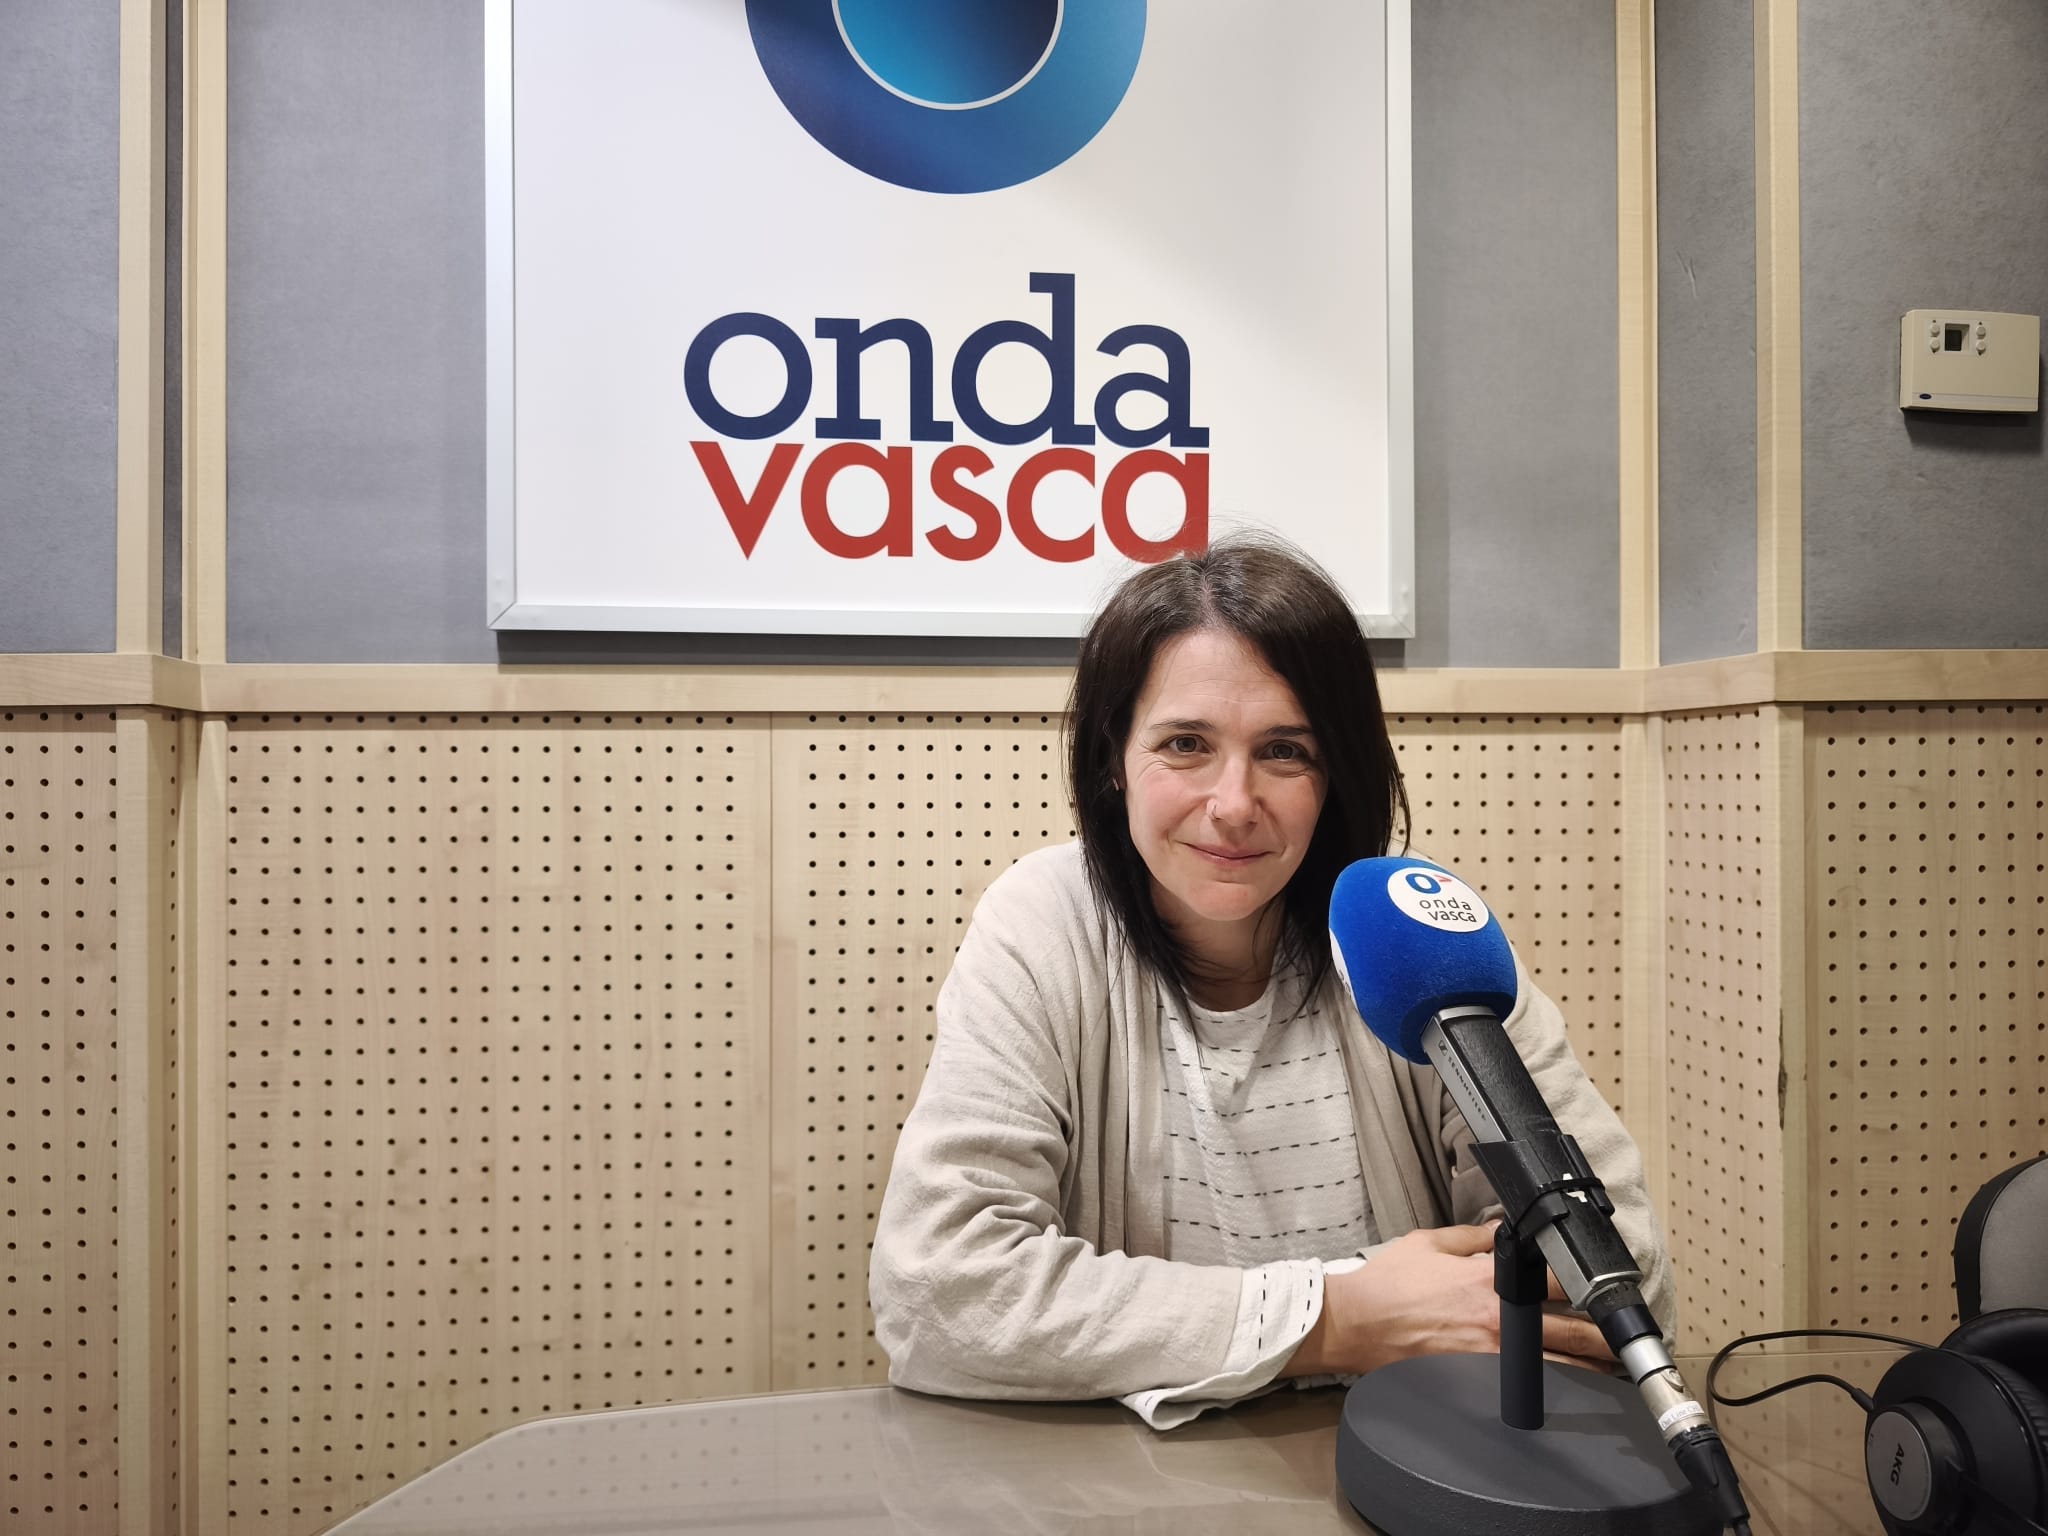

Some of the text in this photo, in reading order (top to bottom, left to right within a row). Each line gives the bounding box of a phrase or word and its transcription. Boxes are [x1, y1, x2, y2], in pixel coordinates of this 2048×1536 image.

[684, 272, 1210, 448] onda
[689, 441, 1210, 563] vasca
[1419, 897, 1472, 911] onda
[1427, 911, 1477, 923] vasca
[1889, 1442, 1905, 1487] AKG
